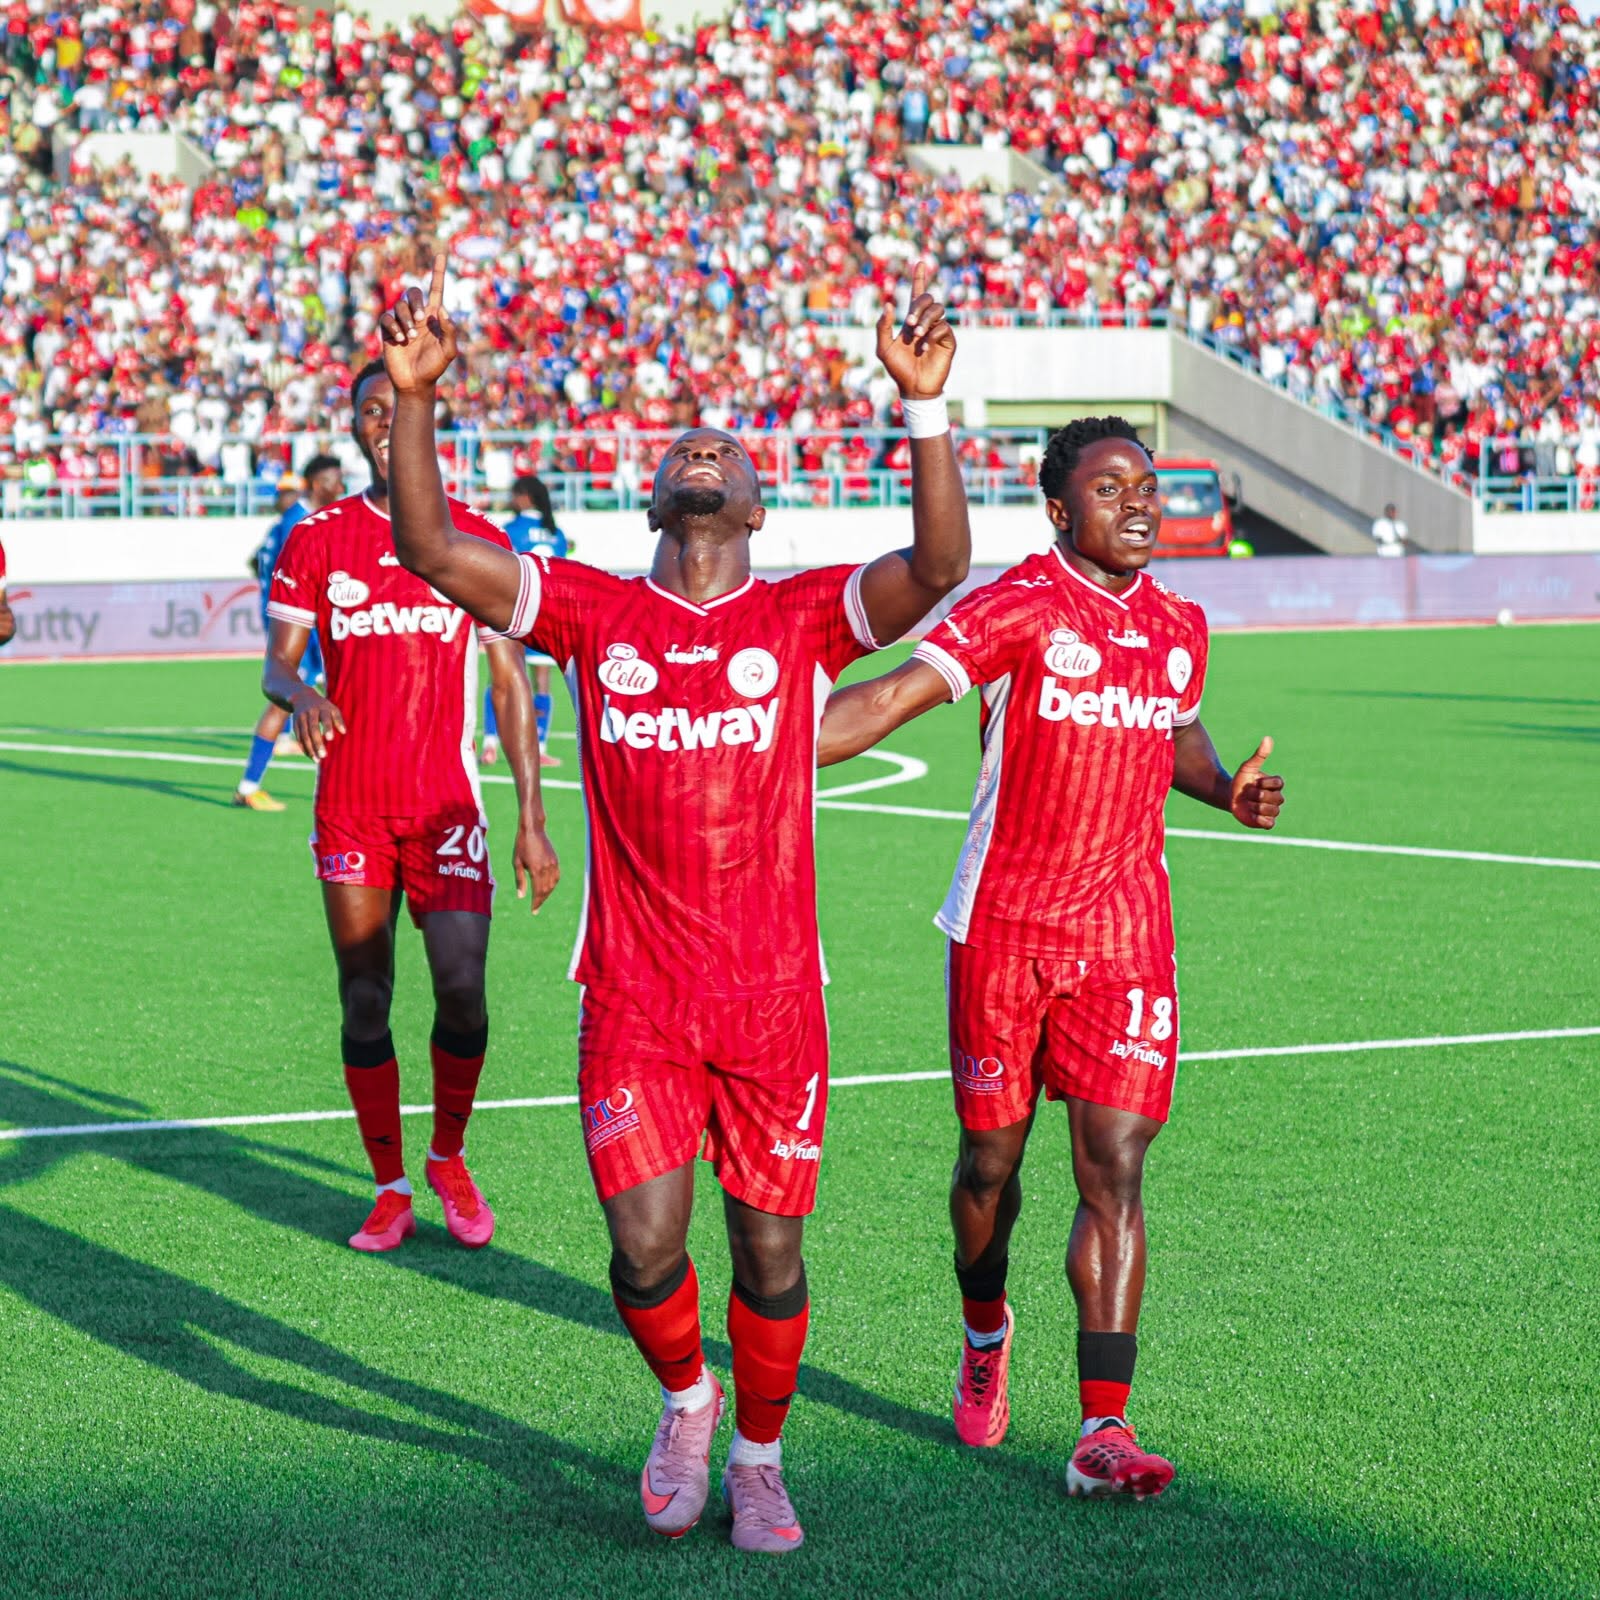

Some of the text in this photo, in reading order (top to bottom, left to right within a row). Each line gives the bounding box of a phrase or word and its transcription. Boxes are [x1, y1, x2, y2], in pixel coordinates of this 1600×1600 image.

[333, 584, 359, 602] Cola
[331, 602, 466, 643] betway
[606, 661, 648, 689] Cola
[1052, 646, 1090, 671] Cola
[600, 695, 779, 753] betway
[436, 824, 484, 863] 20
[1125, 988, 1173, 1041] 18
[796, 1071, 819, 1130] 1
